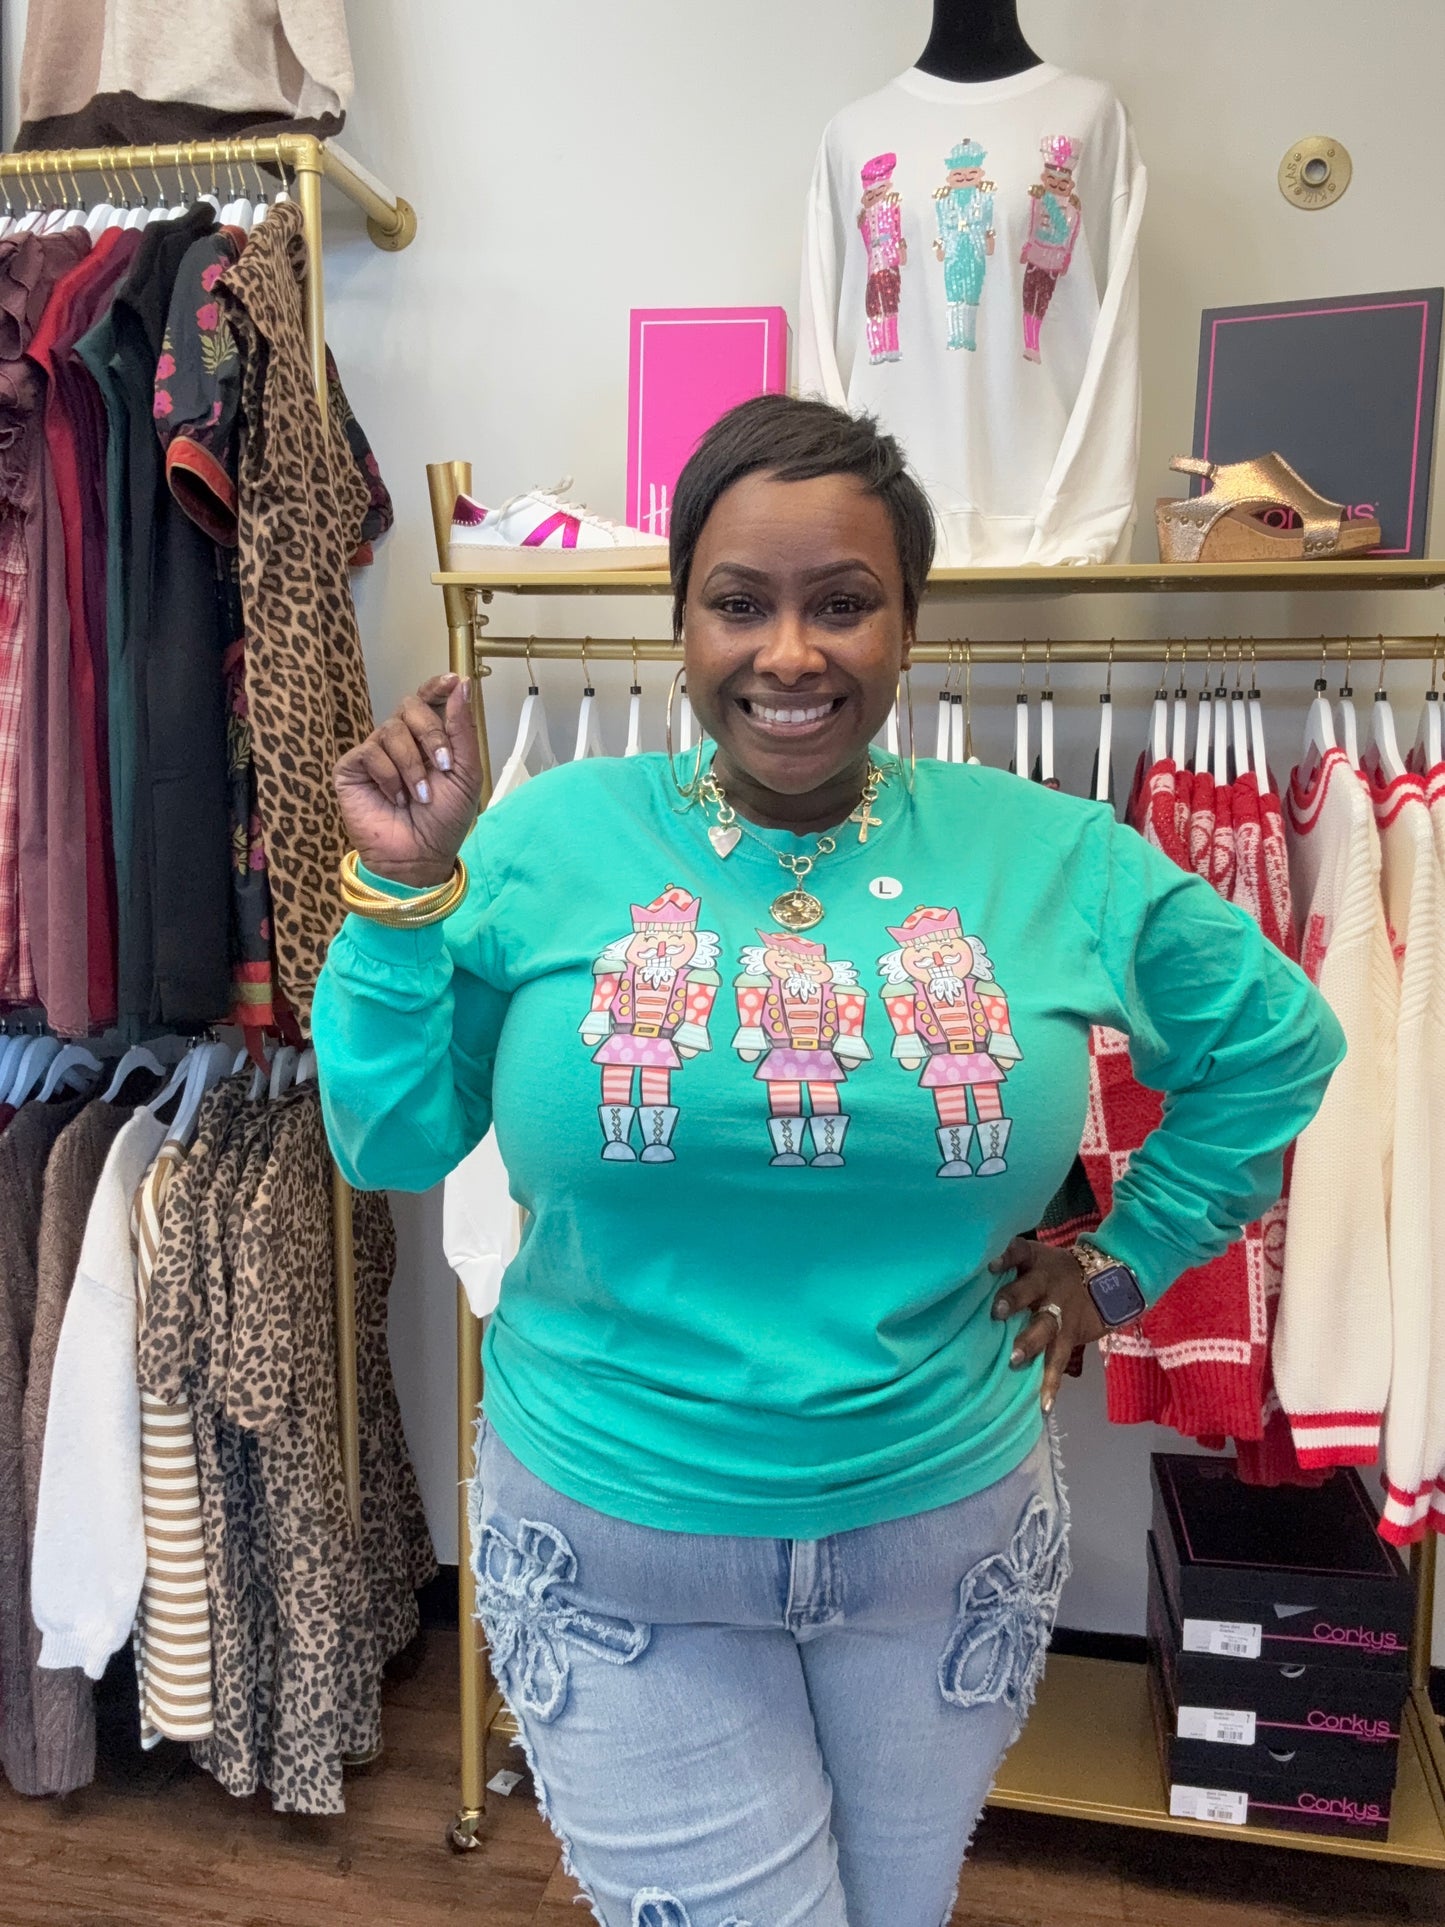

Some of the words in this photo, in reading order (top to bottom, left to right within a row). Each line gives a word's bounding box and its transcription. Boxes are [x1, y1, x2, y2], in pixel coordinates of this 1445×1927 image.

[878, 881, 892, 895] L
[1313, 1622, 1397, 1649] Corkys
[1307, 1710, 1390, 1737] Corkys
[1298, 1792, 1380, 1820] Corkys
